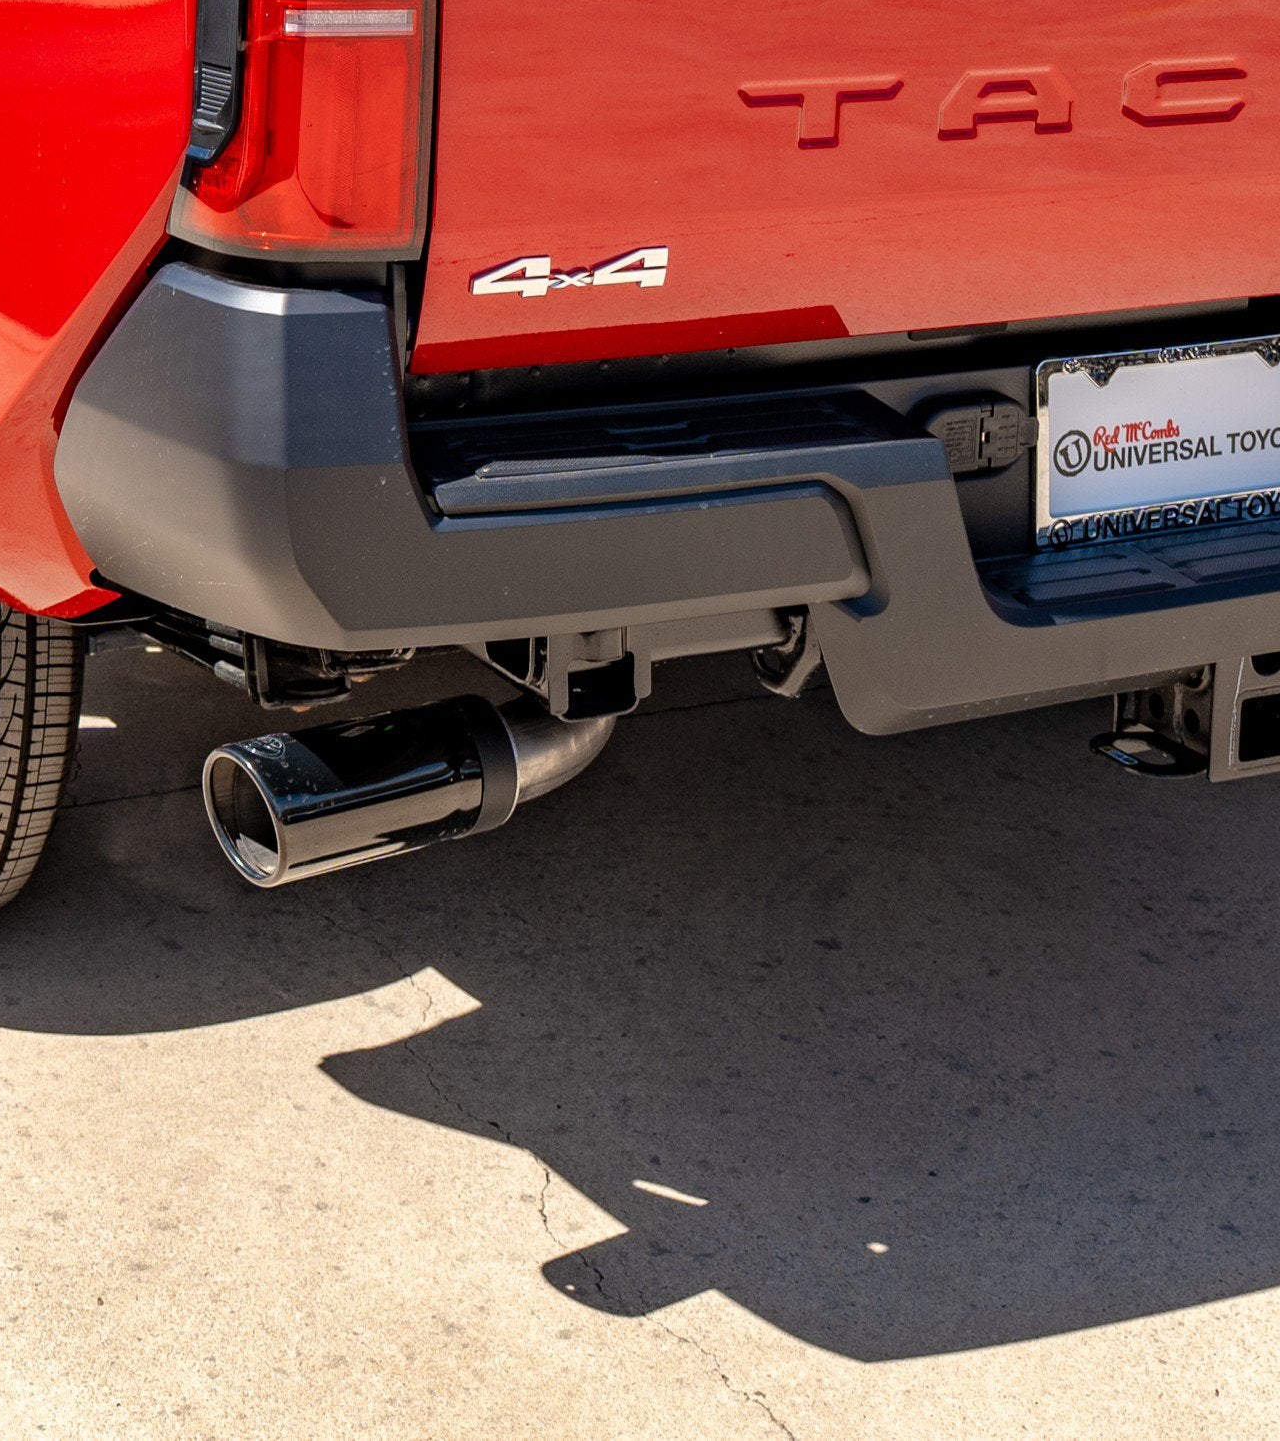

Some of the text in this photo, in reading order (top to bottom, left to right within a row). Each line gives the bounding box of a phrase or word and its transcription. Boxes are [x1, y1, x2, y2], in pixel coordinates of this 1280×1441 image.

[470, 245, 669, 298] 4x4
[1093, 418, 1180, 453] Red McCombs
[1093, 436, 1223, 472] UNIVERSAL
[1082, 498, 1221, 541] UNIVERSAL
